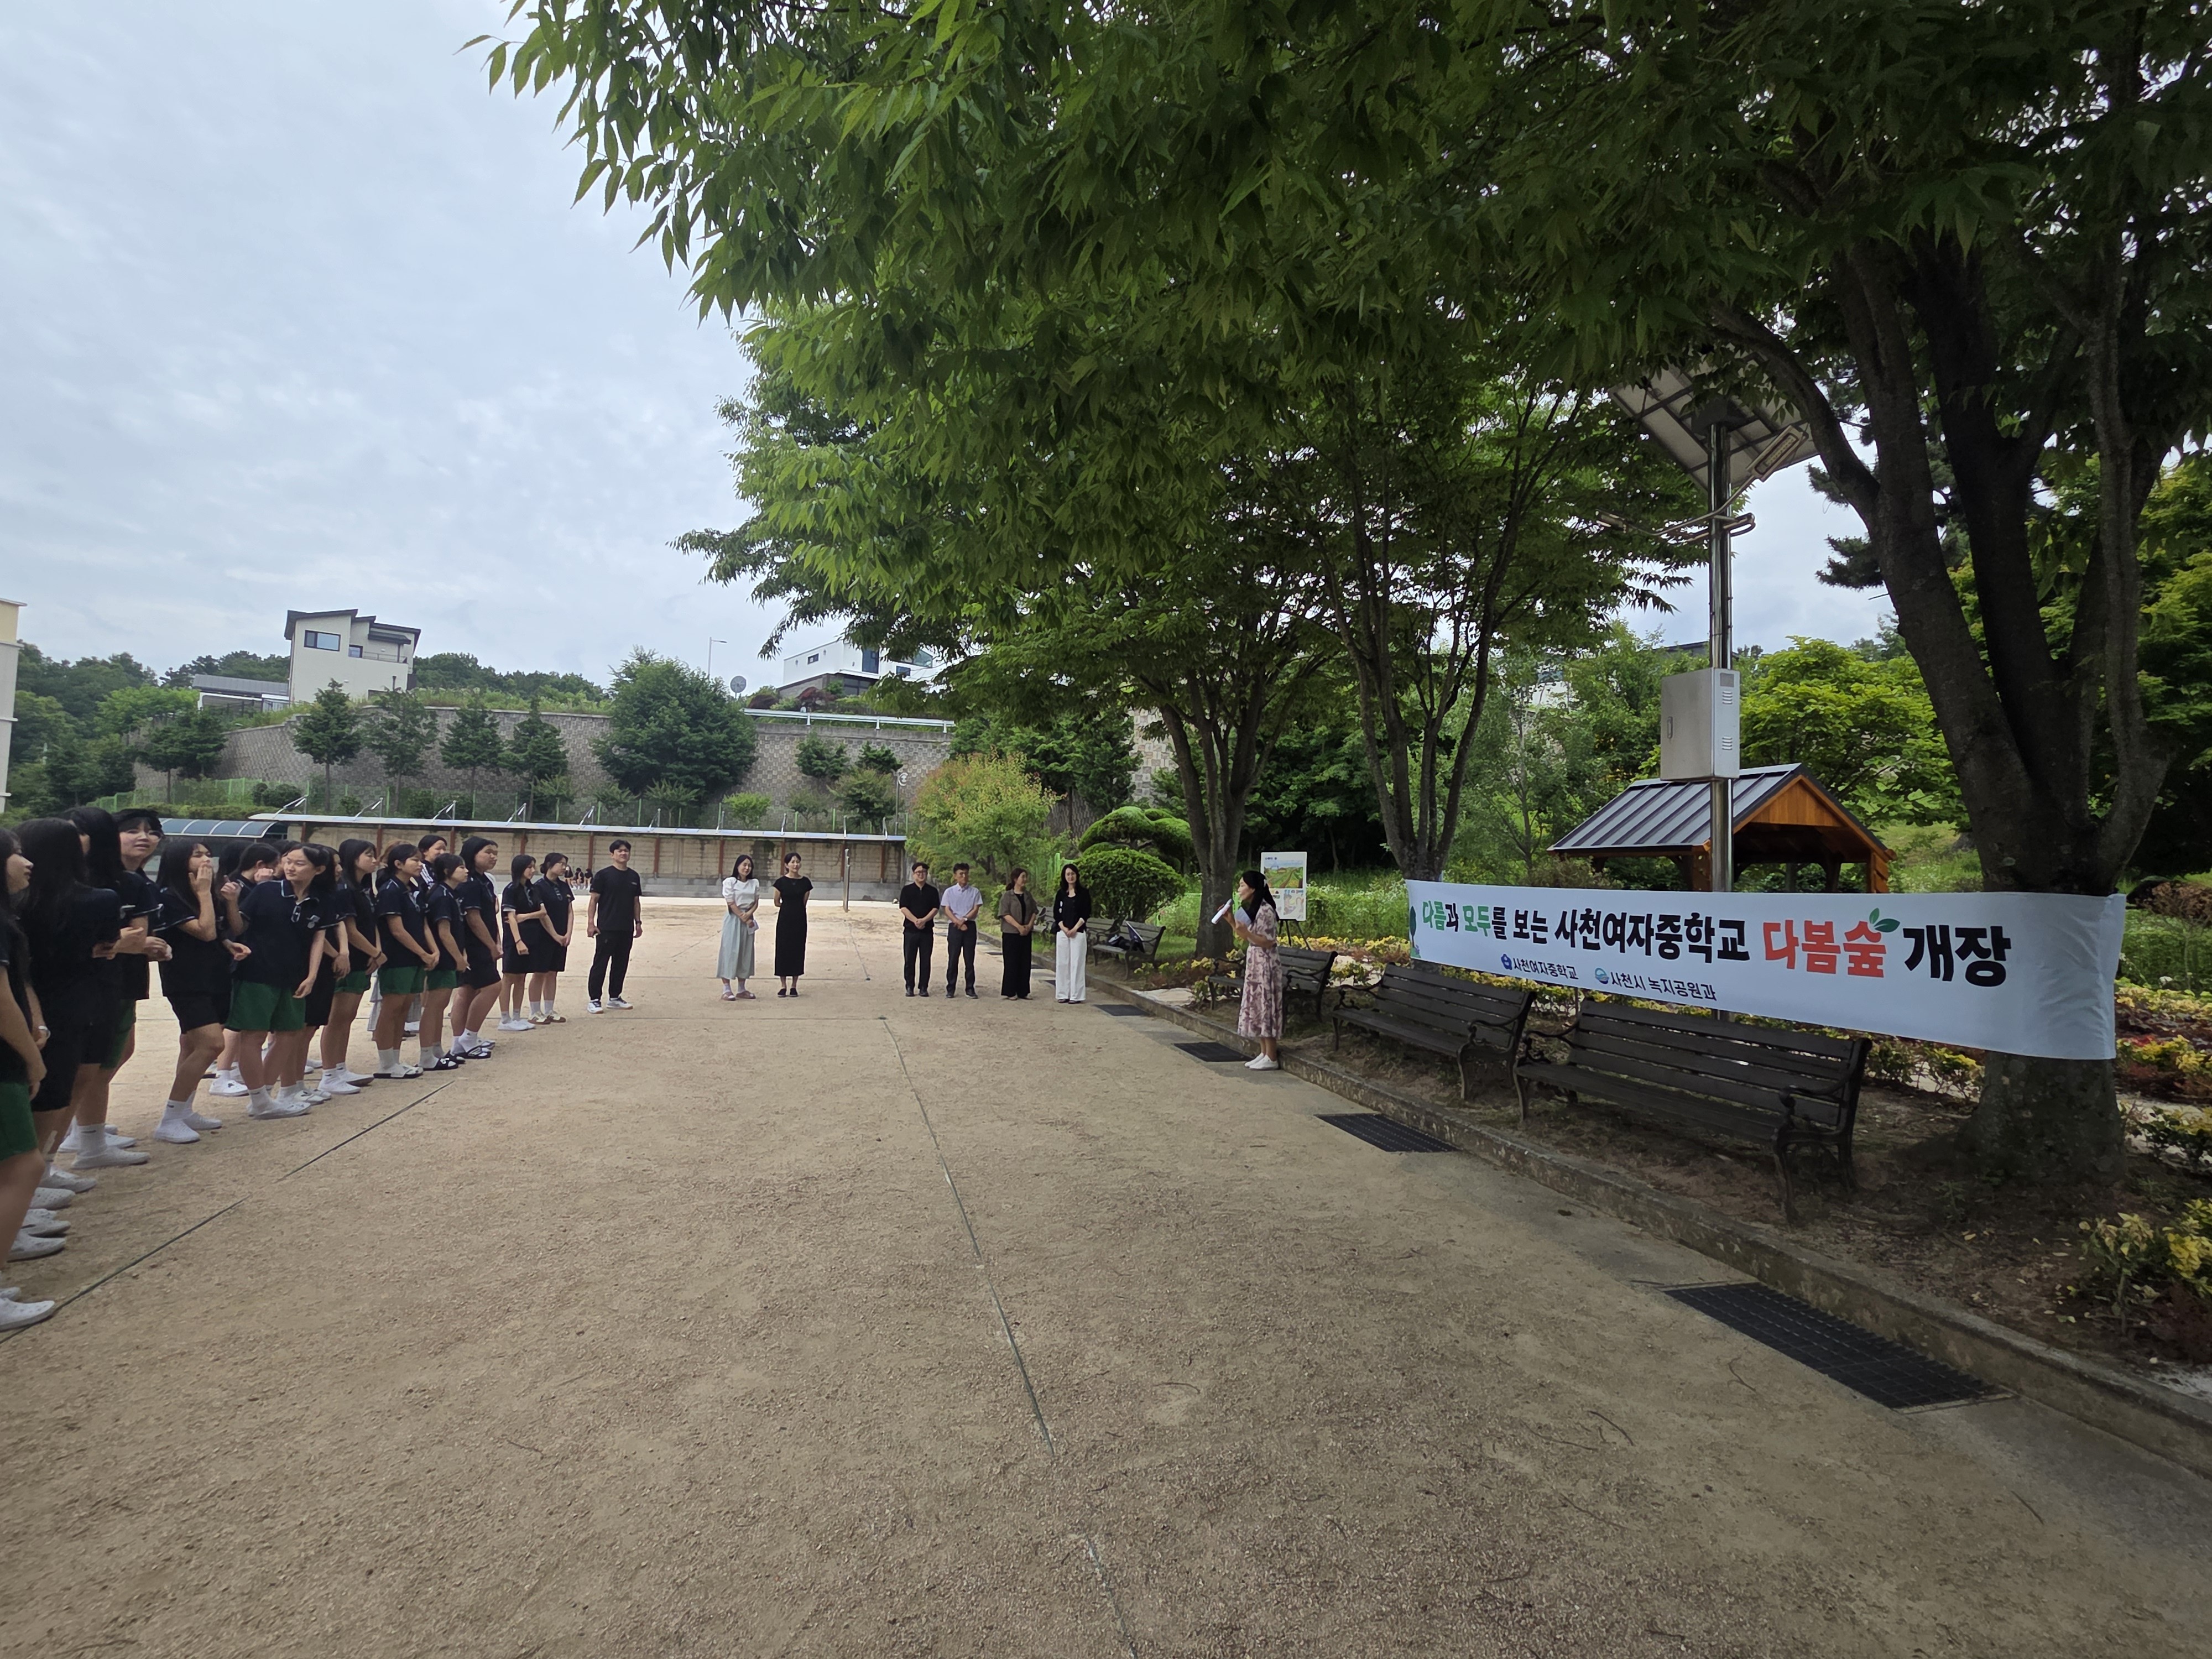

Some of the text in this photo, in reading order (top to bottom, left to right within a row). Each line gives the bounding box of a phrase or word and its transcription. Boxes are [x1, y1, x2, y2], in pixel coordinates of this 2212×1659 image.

[1422, 900, 2011, 987] 다름과 모두를 보는 사천여자중학교 다봄숲 개장
[1512, 957, 1579, 980] 사천여자중학교
[1610, 972, 1717, 1001] 사천시 녹지공원과
